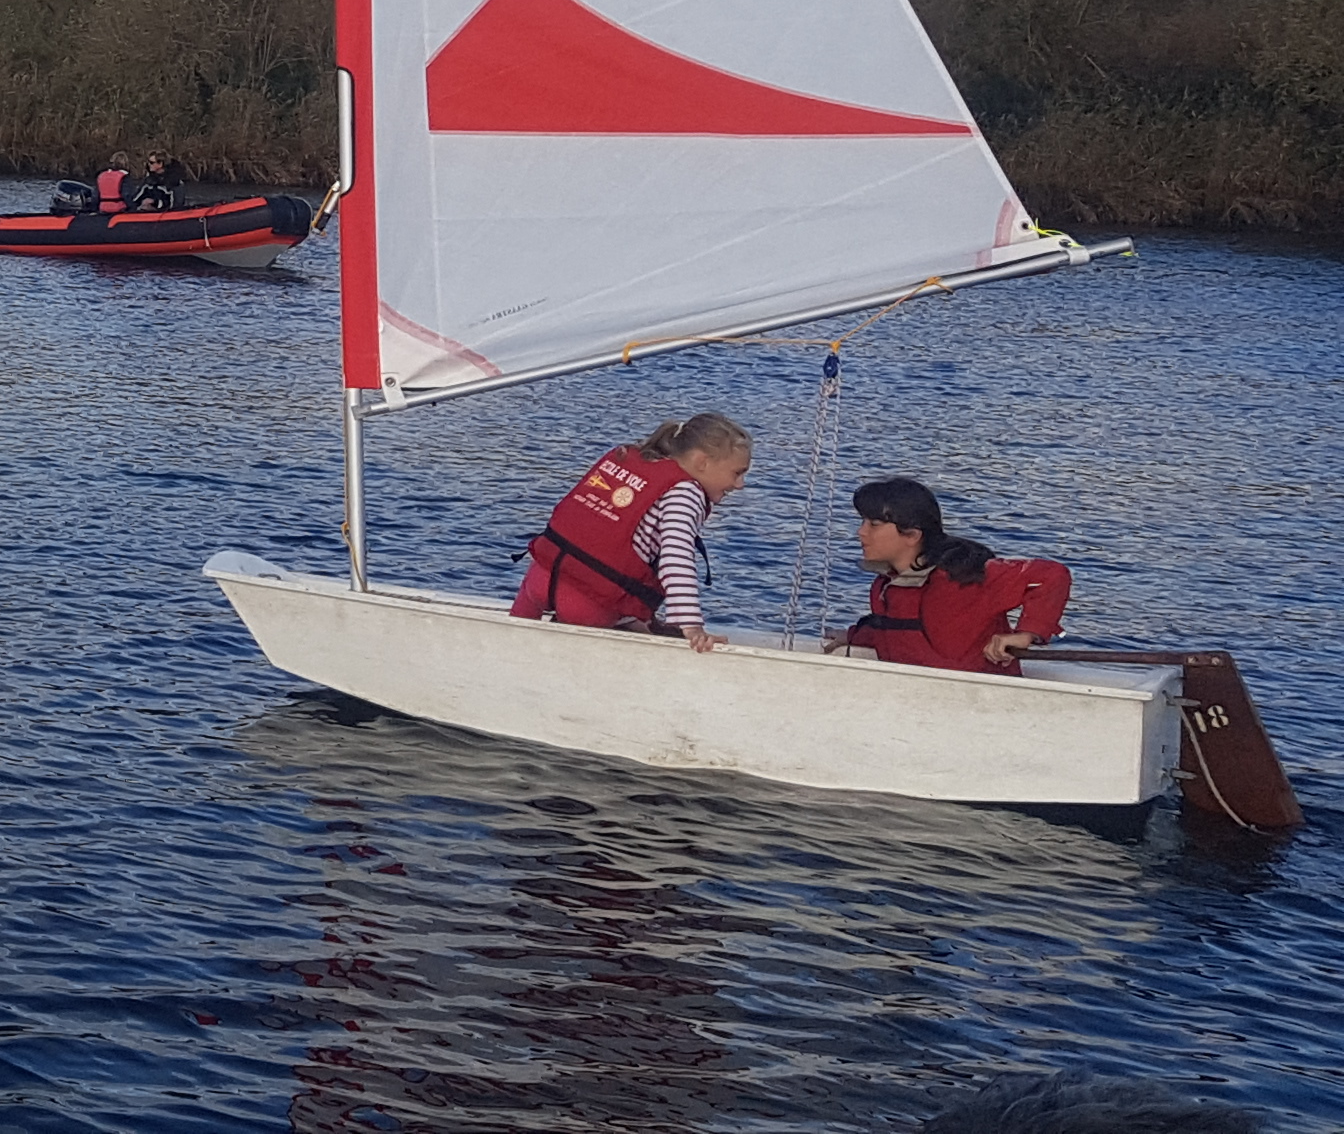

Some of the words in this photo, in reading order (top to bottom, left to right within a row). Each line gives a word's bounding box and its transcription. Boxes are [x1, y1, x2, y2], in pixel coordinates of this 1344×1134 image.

[615, 468, 630, 481] DE
[625, 473, 648, 492] VOILE
[1193, 704, 1230, 733] 18
